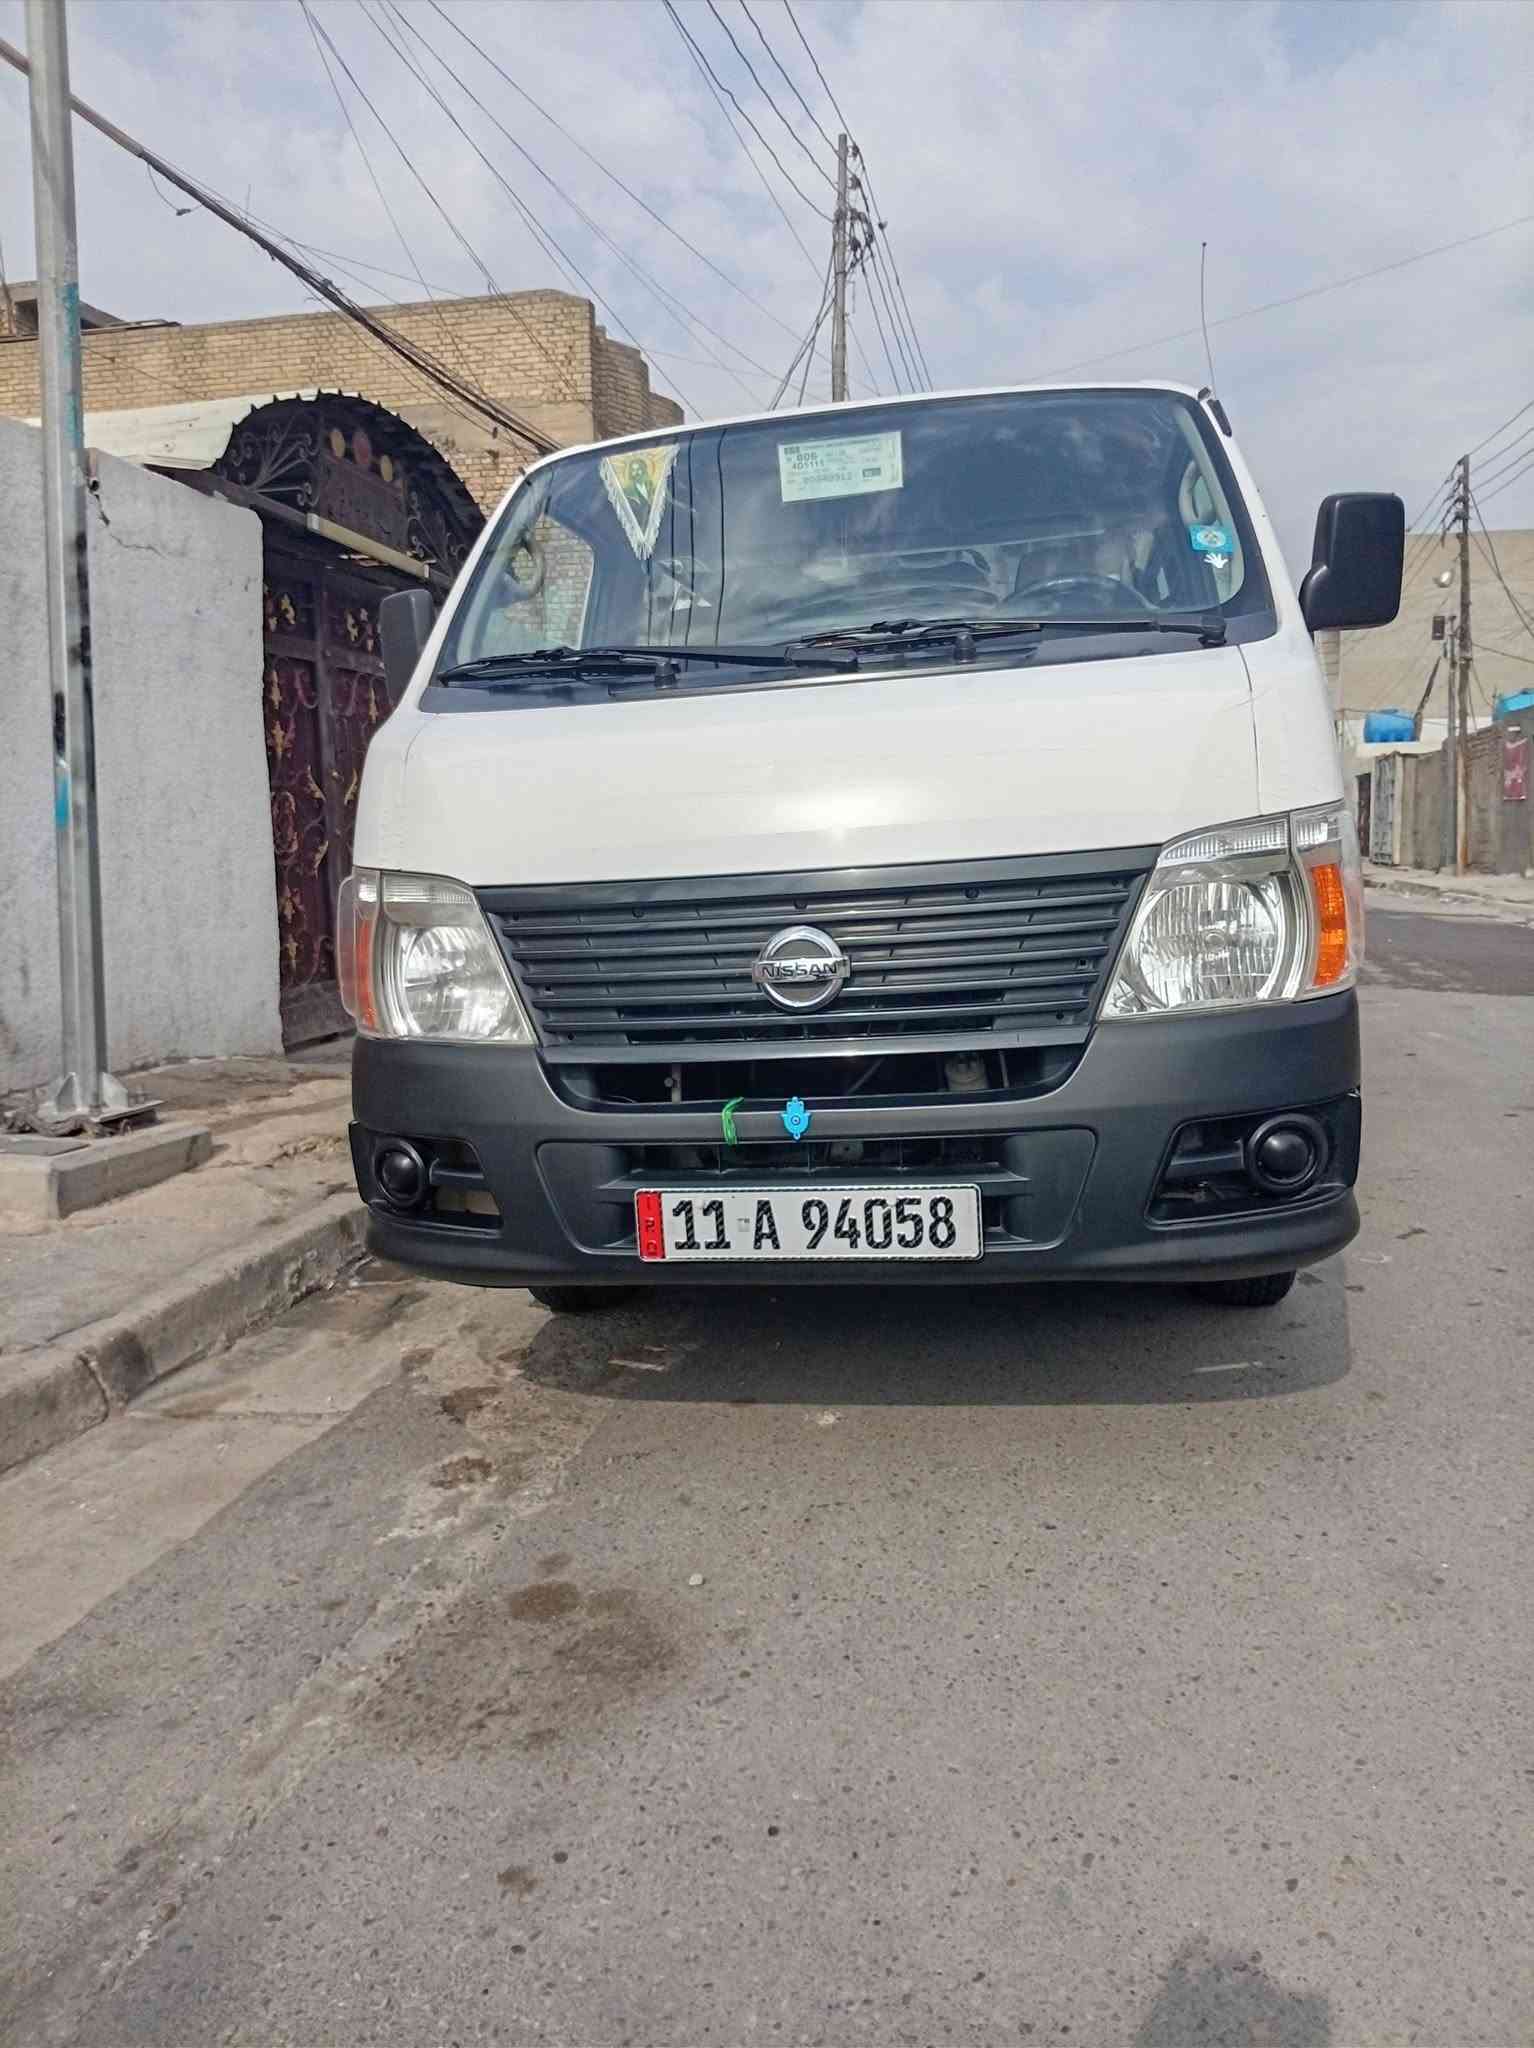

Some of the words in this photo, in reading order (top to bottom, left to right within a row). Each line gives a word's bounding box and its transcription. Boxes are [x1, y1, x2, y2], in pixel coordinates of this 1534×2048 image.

[761, 963, 837, 977] NISSAN
[672, 1199, 731, 1250] 11
[753, 1199, 781, 1250] A
[801, 1196, 956, 1249] 94058
